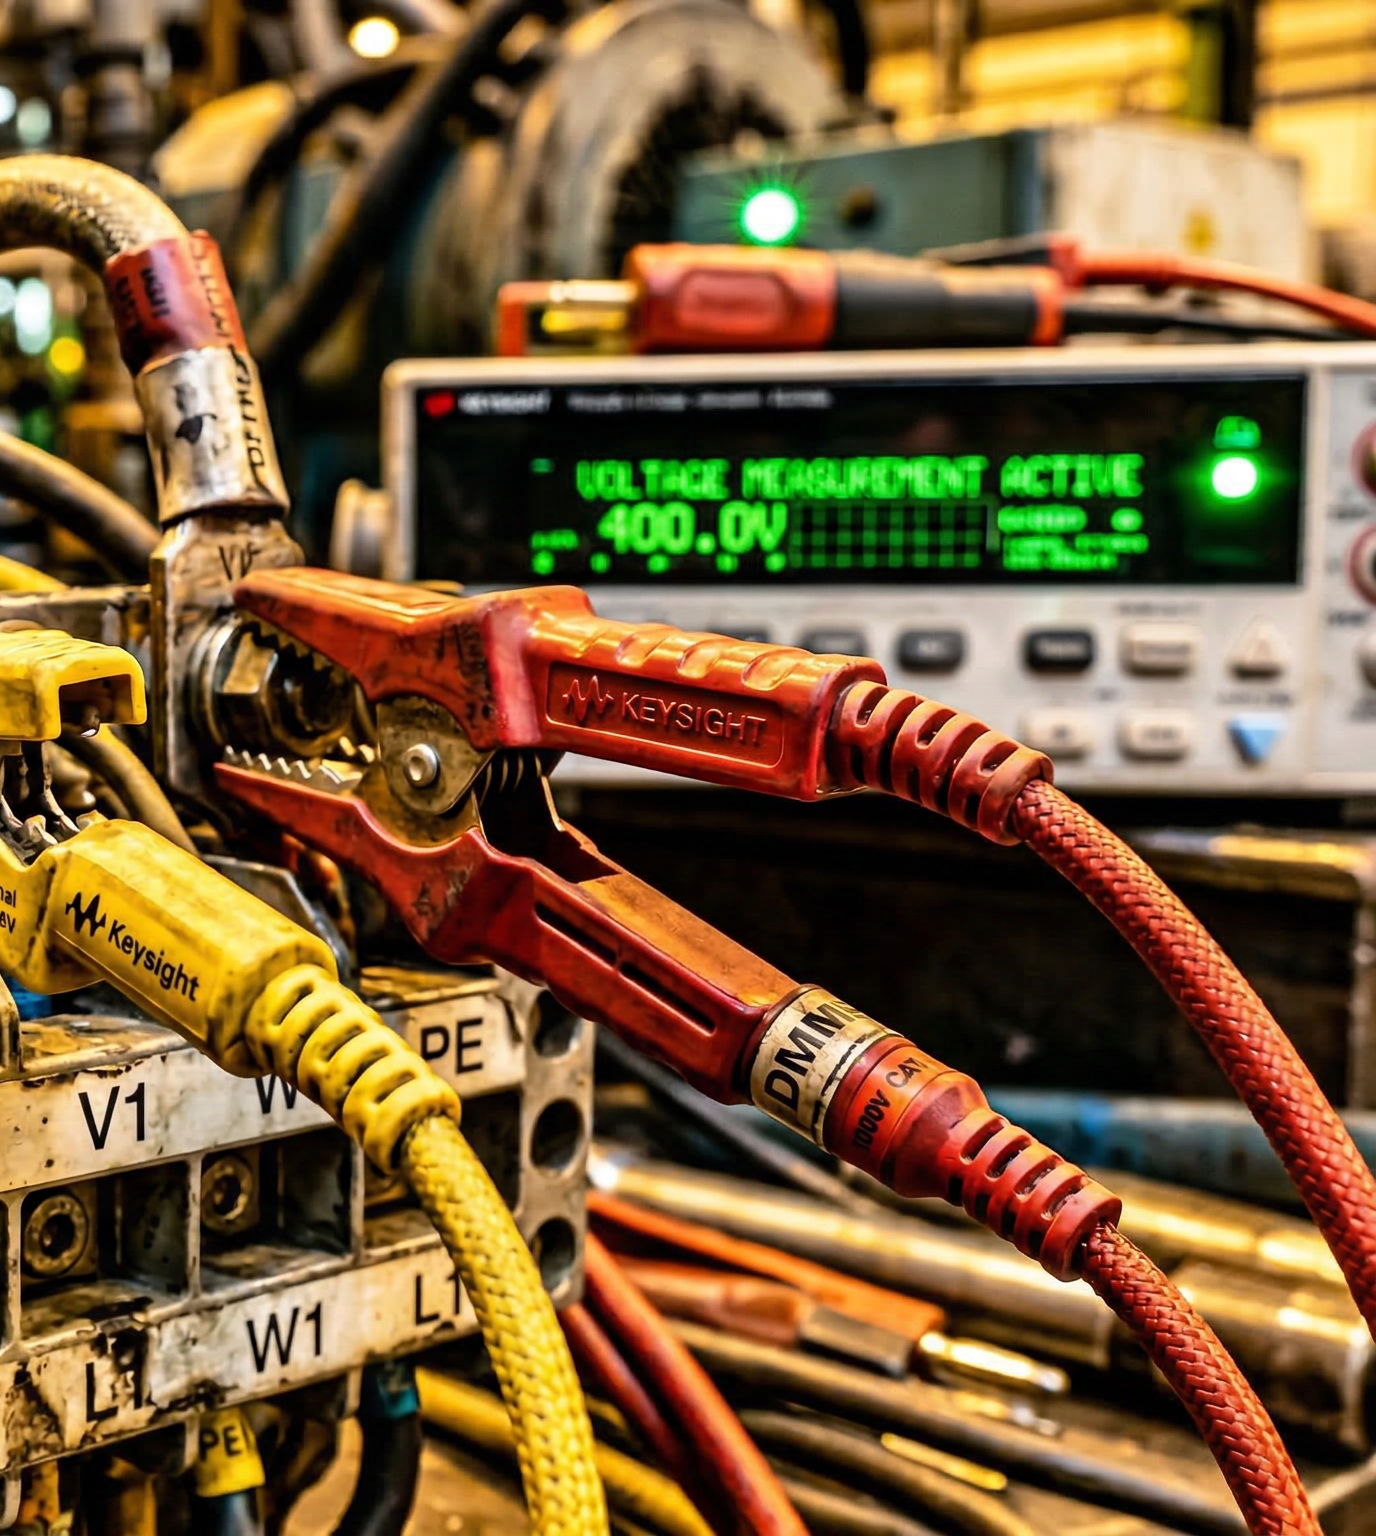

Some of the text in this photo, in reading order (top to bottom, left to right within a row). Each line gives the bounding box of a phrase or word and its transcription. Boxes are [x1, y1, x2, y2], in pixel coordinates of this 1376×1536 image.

[575, 453, 1145, 502] VOLTAGE MEASUREMENT ACTIVE
[597, 500, 789, 555] 400.0V
[620, 691, 768, 747] KEYSIGHT
[108, 919, 201, 1003] Keysight
[77, 1082, 148, 1152] V1
[420, 1018, 483, 1075] PE
[245, 1301, 324, 1374] W1
[414, 1272, 462, 1327] L1
[199, 1424, 242, 1462] PE
